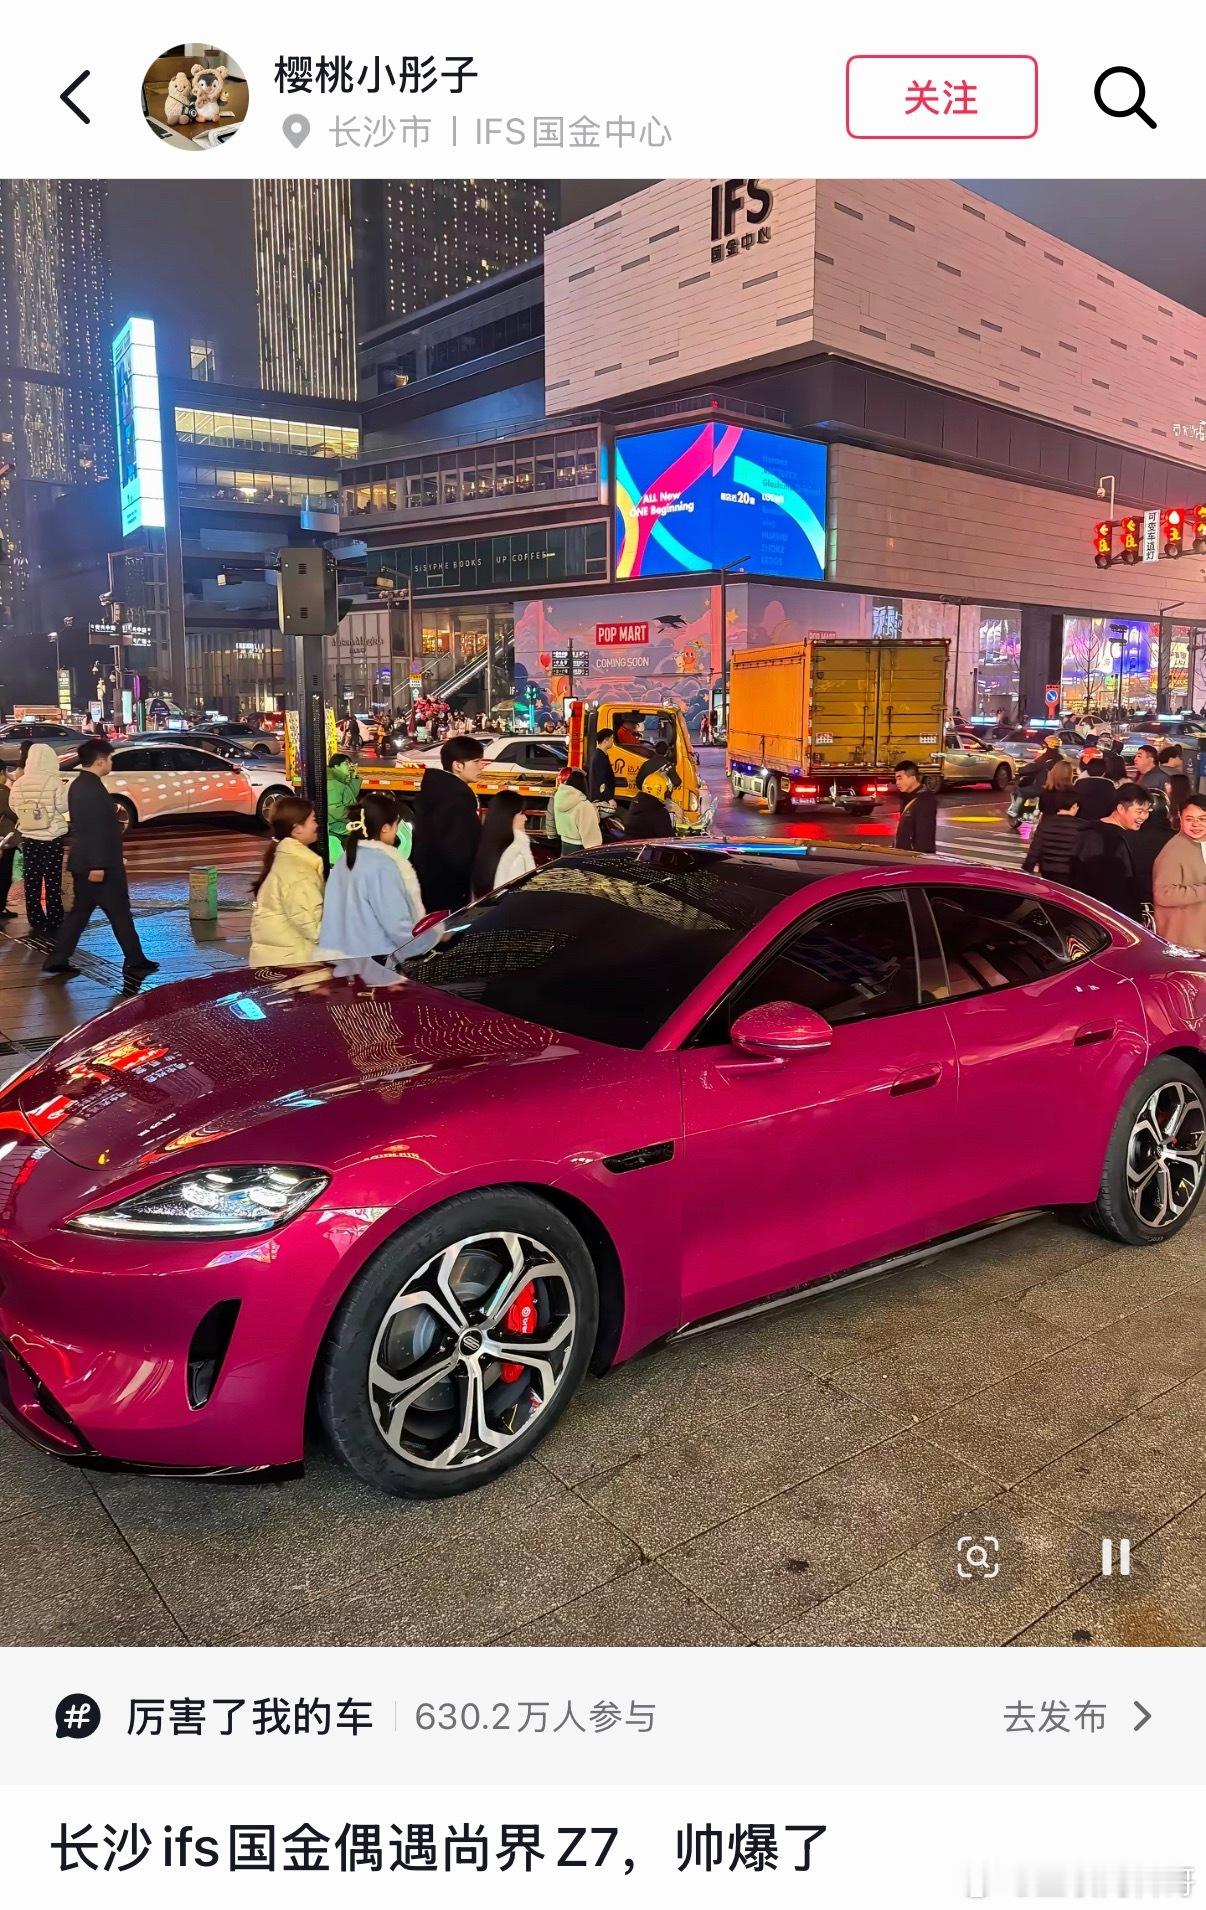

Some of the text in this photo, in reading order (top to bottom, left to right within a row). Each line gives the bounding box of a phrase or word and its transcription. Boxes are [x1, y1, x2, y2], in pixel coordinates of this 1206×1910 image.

[711, 179, 773, 241] IFS
[643, 491, 681, 504] ALL New
[650, 501, 694, 516] Beginning
[1145, 511, 1157, 561] 可变车道灯
[453, 558, 482, 569] BOOKS
[496, 555, 507, 564] UP
[597, 624, 648, 643] POP MART
[596, 657, 626, 669] COMING
[626, 655, 649, 668] SOON
